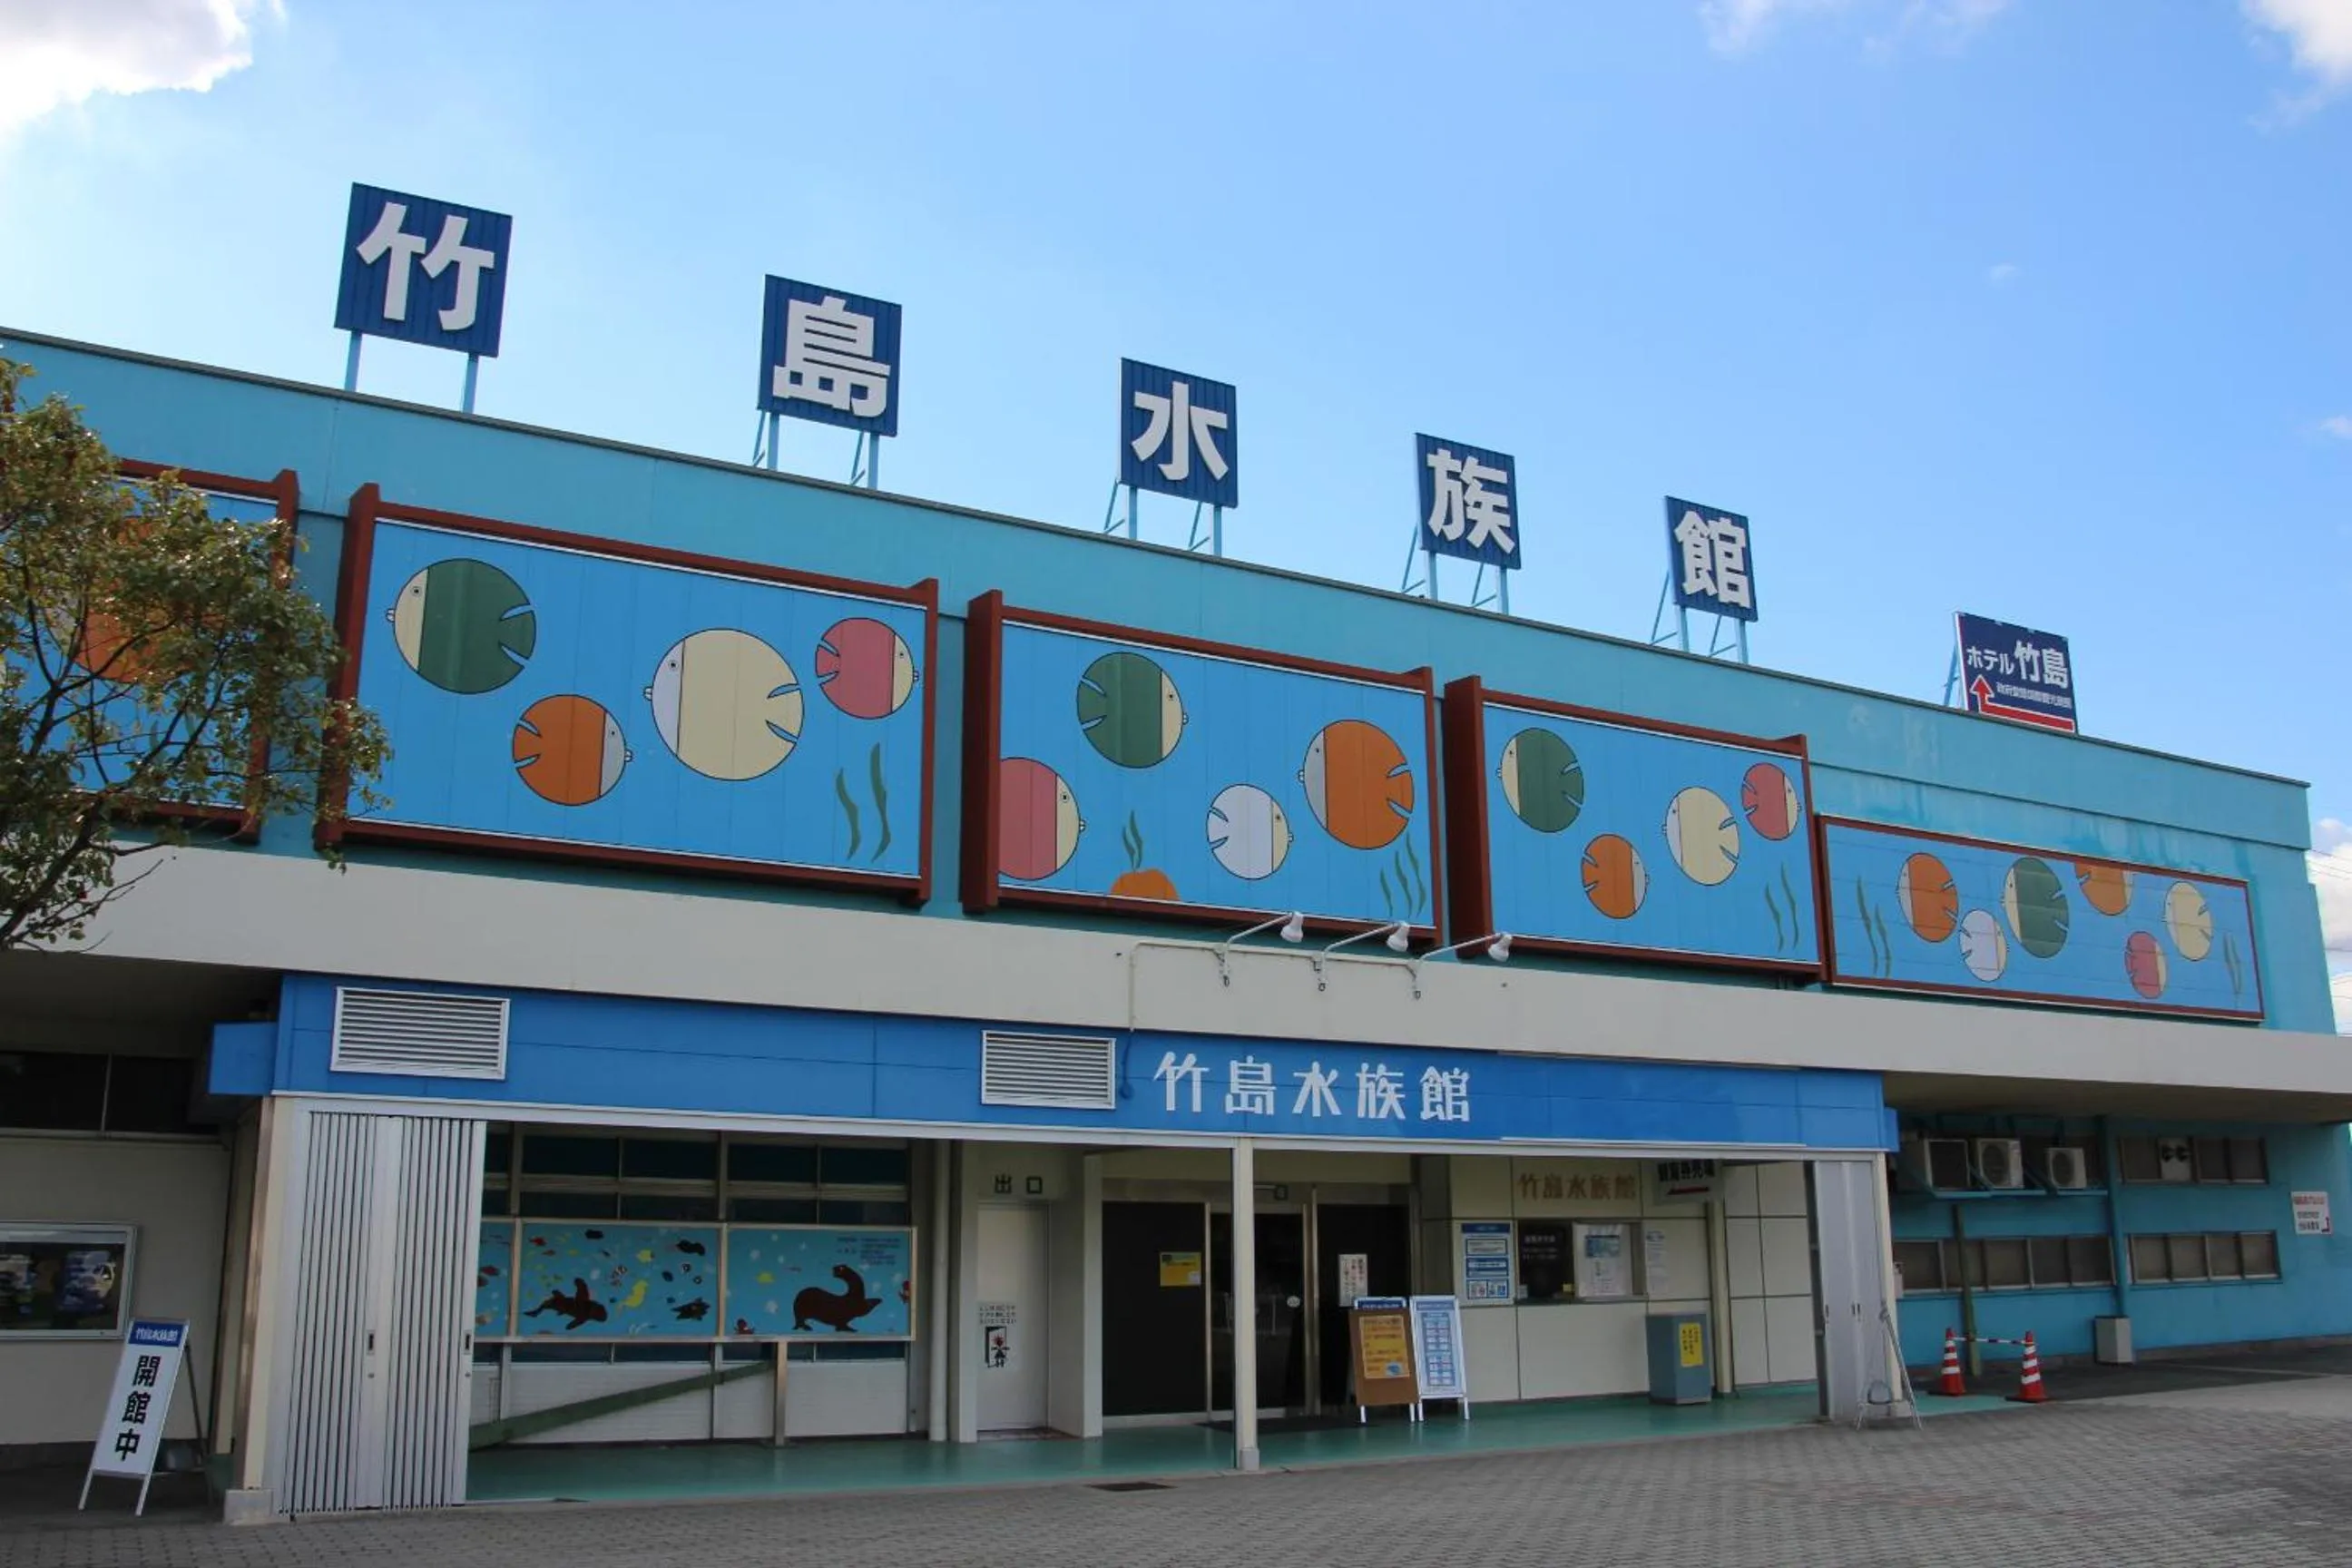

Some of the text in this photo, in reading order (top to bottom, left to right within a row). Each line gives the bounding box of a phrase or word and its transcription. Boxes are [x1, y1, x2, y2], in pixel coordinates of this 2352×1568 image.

[1966, 640, 2070, 690] ホテル竹島
[1153, 1051, 1470, 1122] 竹島水族館
[995, 1173, 1043, 1194] 出口
[115, 1355, 161, 1461] 開館中
